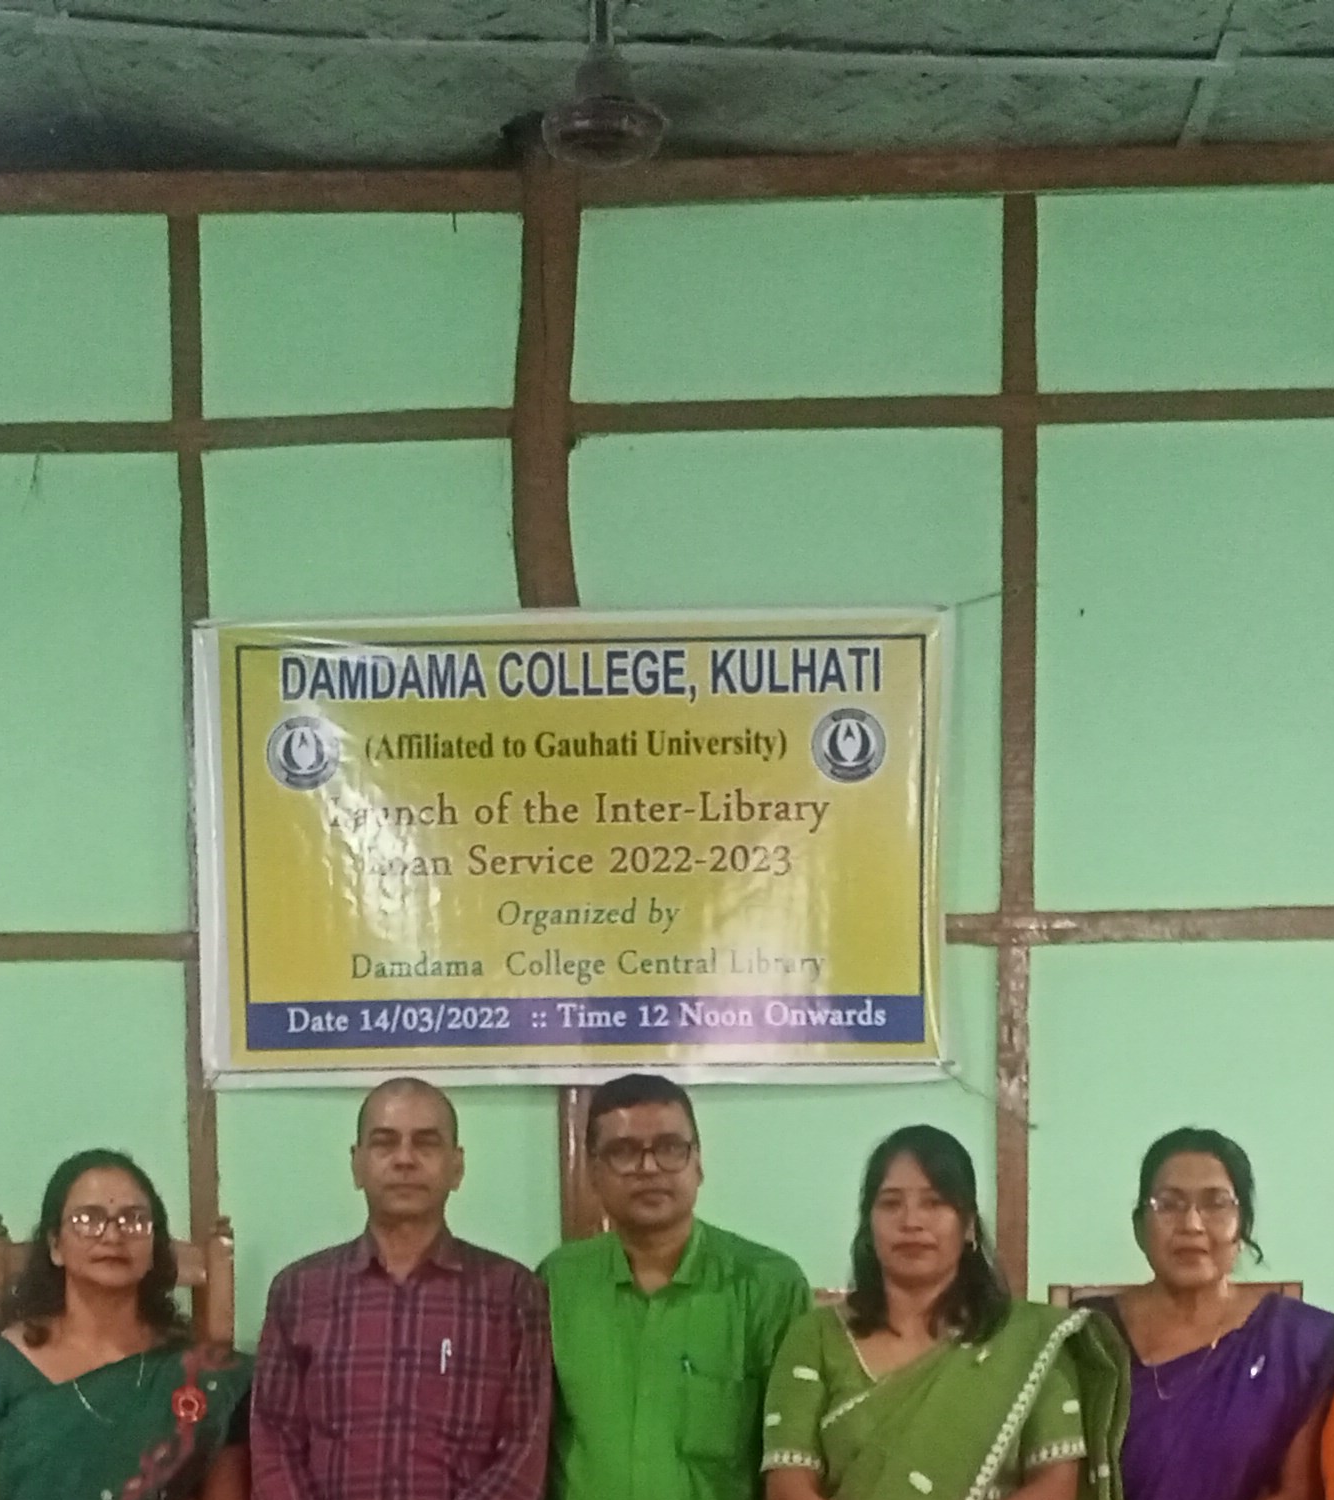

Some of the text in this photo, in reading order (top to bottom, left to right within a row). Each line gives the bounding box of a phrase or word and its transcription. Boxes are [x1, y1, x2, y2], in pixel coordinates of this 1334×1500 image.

[281, 647, 882, 703] DAMDAMA COLLEGE, KULHATI
[365, 728, 788, 762] (Affiliated to Gauhati University)
[475, 791, 514, 825] of
[524, 791, 580, 824] the
[595, 787, 830, 833] Inter-Library
[468, 844, 595, 876] Service
[609, 845, 793, 877] 2022-2023
[496, 897, 682, 936] Organized by
[351, 951, 485, 980] Damdama
[505, 948, 606, 985] College
[617, 947, 717, 975] Central
[286, 1007, 349, 1033] Date
[359, 1004, 511, 1034] 14/03/2022
[556, 1002, 627, 1028] Time
[638, 1004, 670, 1028] 12
[679, 1002, 754, 1028] Noon
[765, 999, 887, 1028] Onwards
